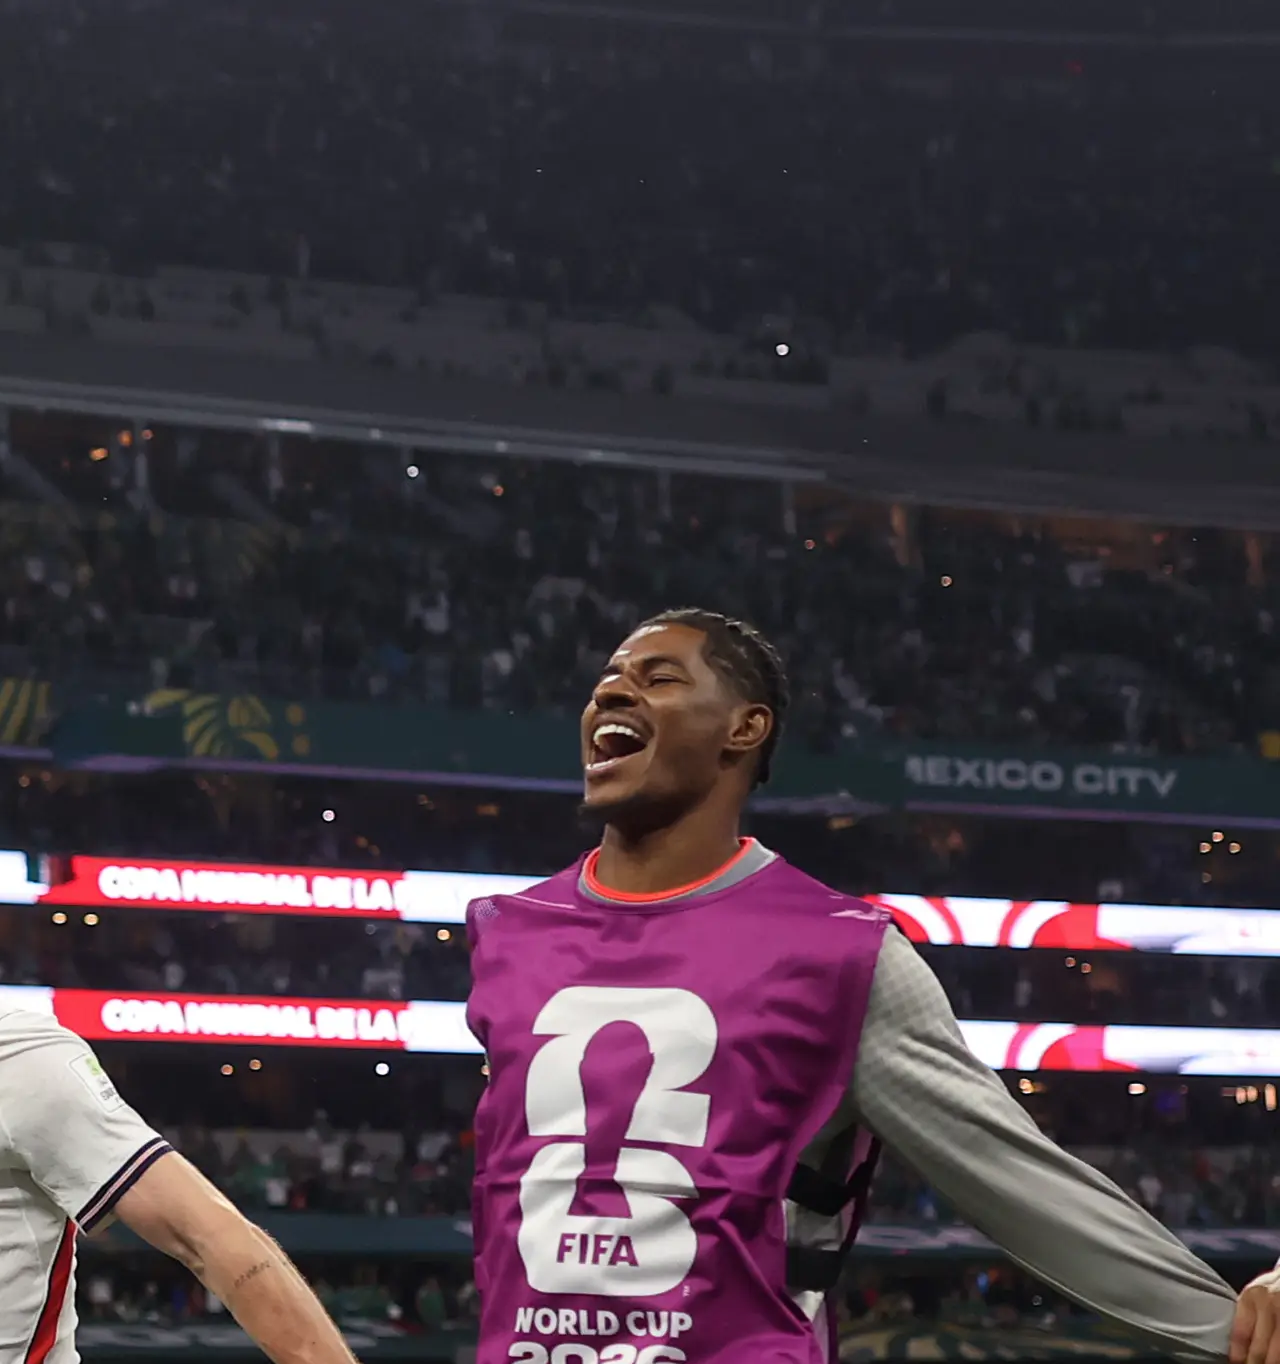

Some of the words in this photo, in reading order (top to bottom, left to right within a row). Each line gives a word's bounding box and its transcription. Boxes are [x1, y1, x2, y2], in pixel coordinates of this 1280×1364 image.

[1072, 763, 1178, 798] CITY
[556, 1233, 639, 1267] FIFA
[626, 1311, 693, 1338] CUP
